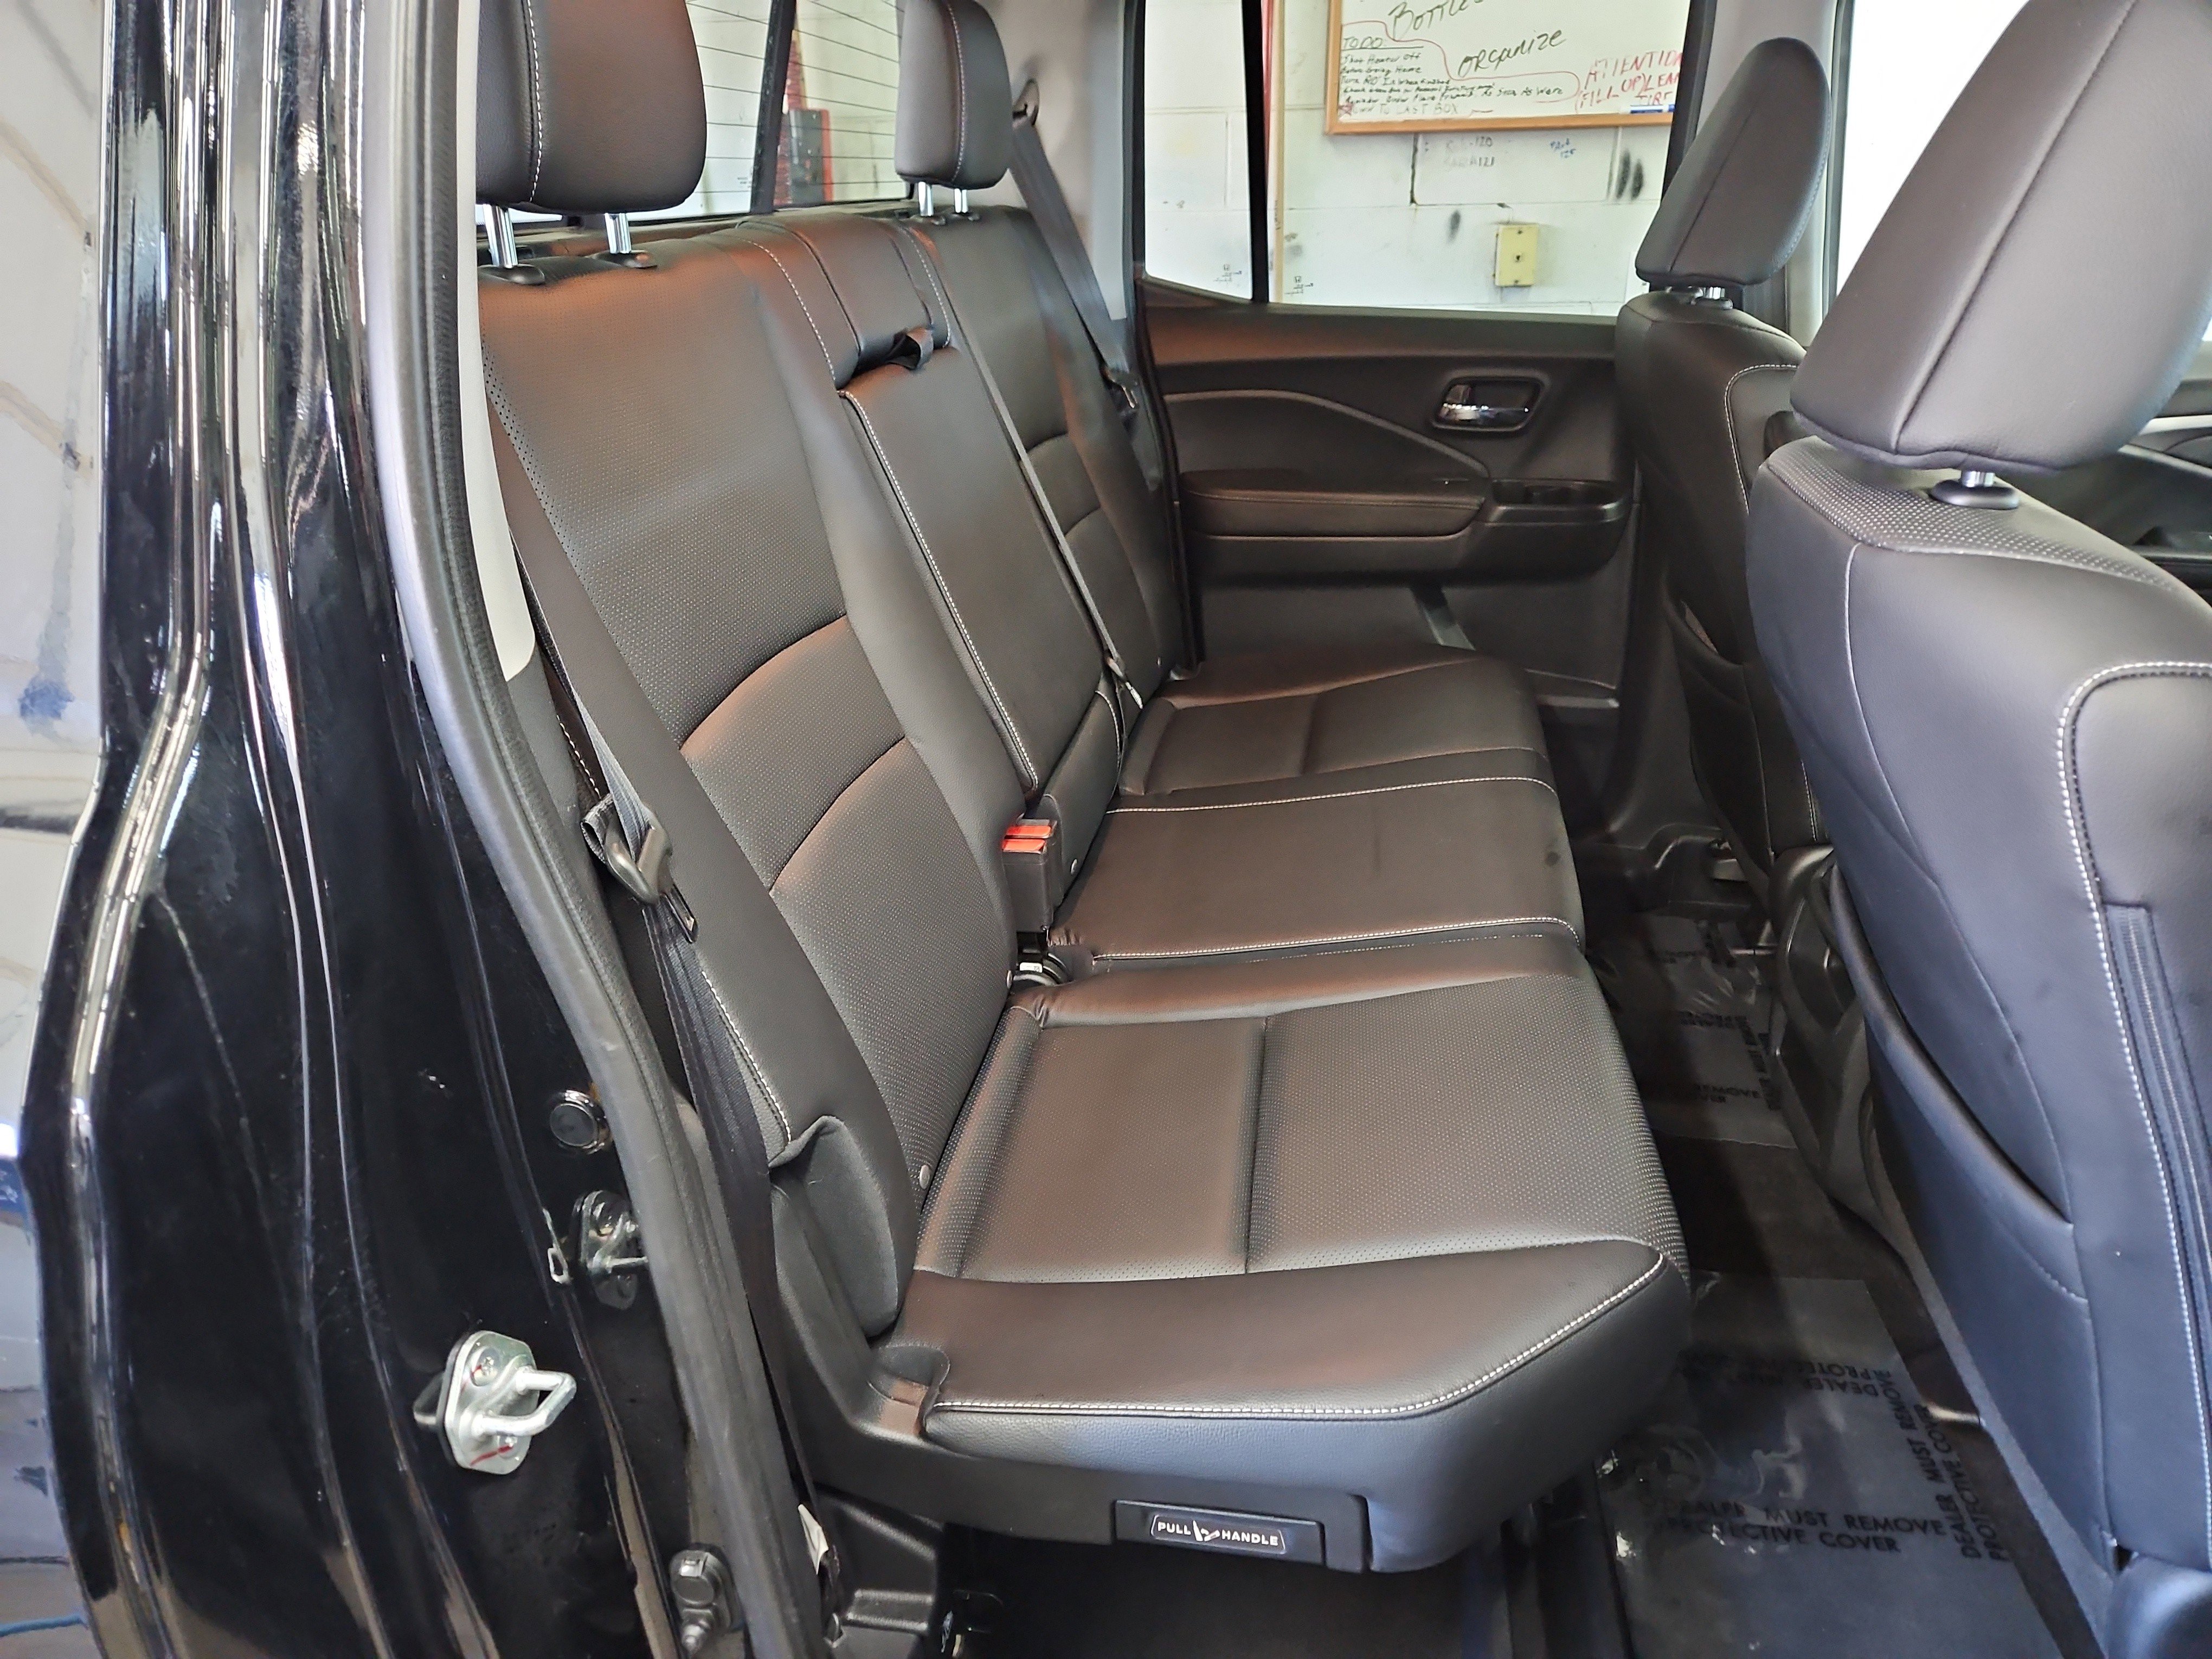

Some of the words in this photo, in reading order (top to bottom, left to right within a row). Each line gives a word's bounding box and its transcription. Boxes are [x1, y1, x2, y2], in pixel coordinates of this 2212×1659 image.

[1157, 1521, 1192, 1536] PULL
[1221, 1529, 1279, 1547] HANDLE
[1844, 1514, 1947, 1536] REMOVE
[1819, 1531, 1901, 1553] COVER
